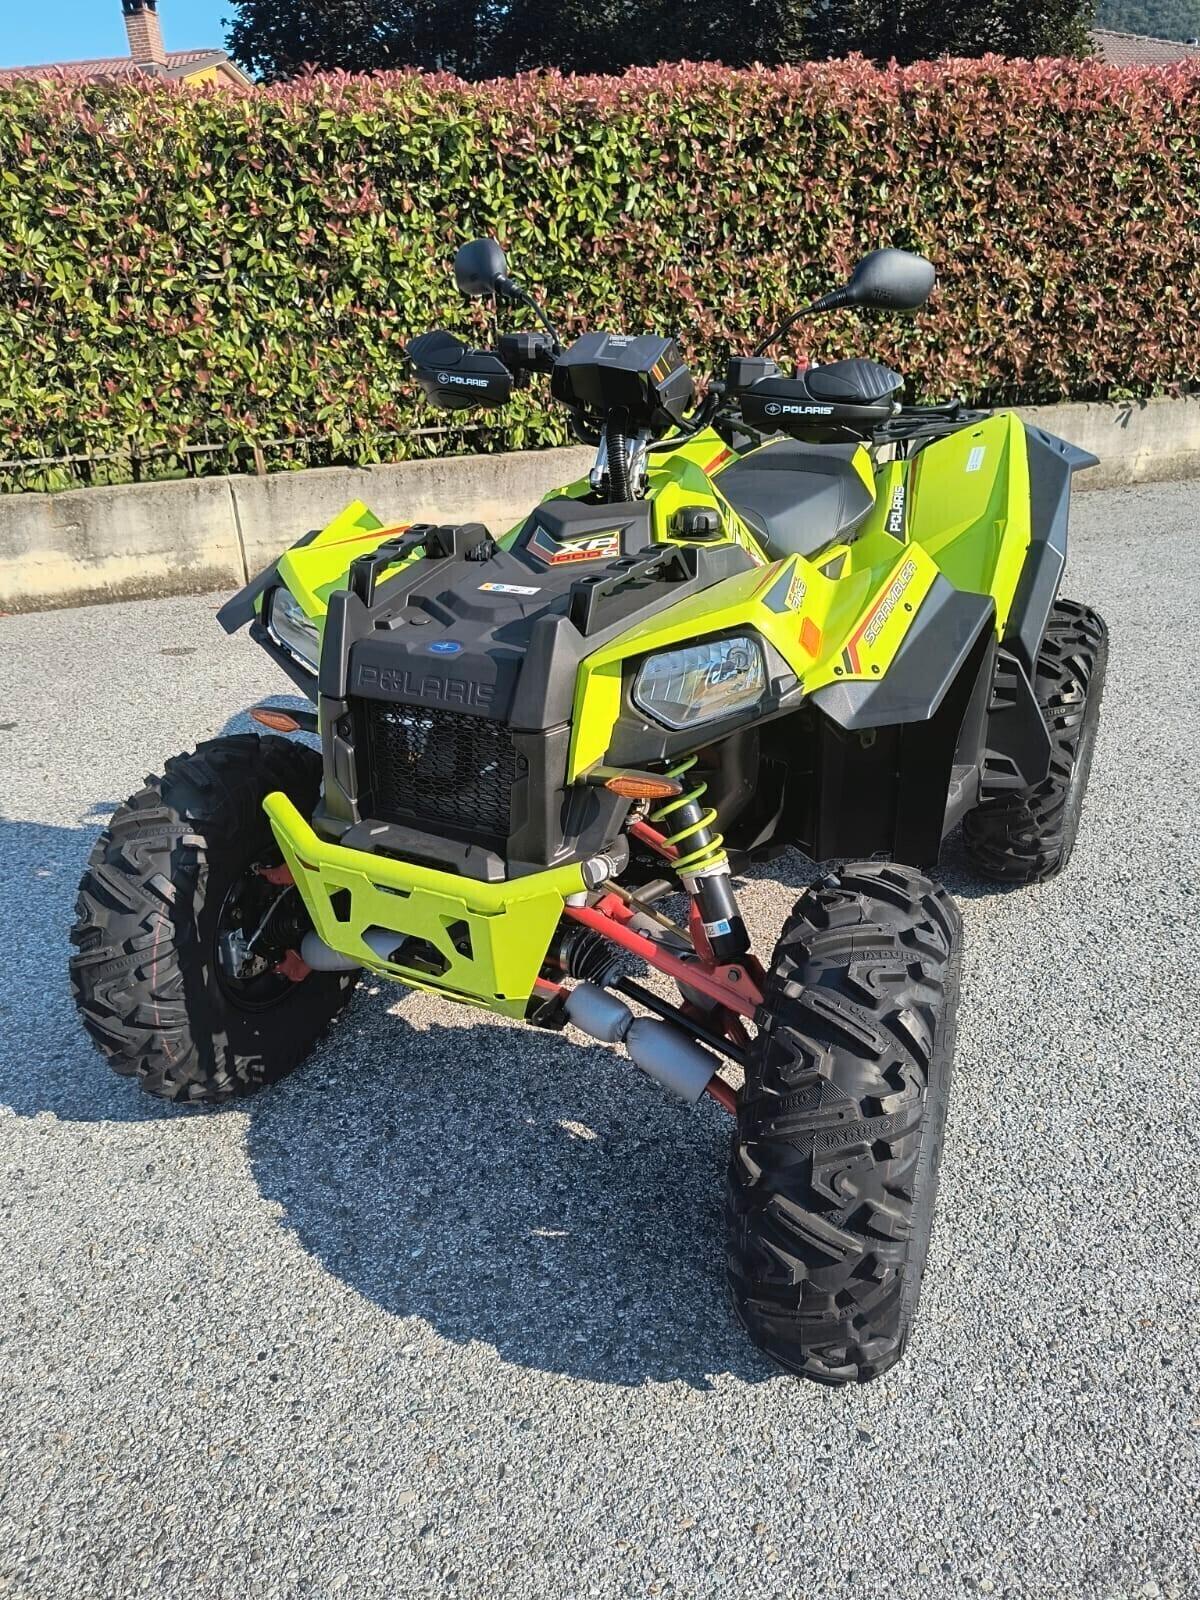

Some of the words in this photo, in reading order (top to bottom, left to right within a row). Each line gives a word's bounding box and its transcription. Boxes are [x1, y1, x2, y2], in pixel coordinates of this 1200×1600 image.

[449, 376, 490, 388] POLARIS
[782, 405, 833, 415] POLARIS
[889, 486, 905, 532] POLARIS
[554, 537, 618, 556] XP
[863, 559, 917, 648] SCRAMBLER
[358, 664, 497, 709] POLARIS
